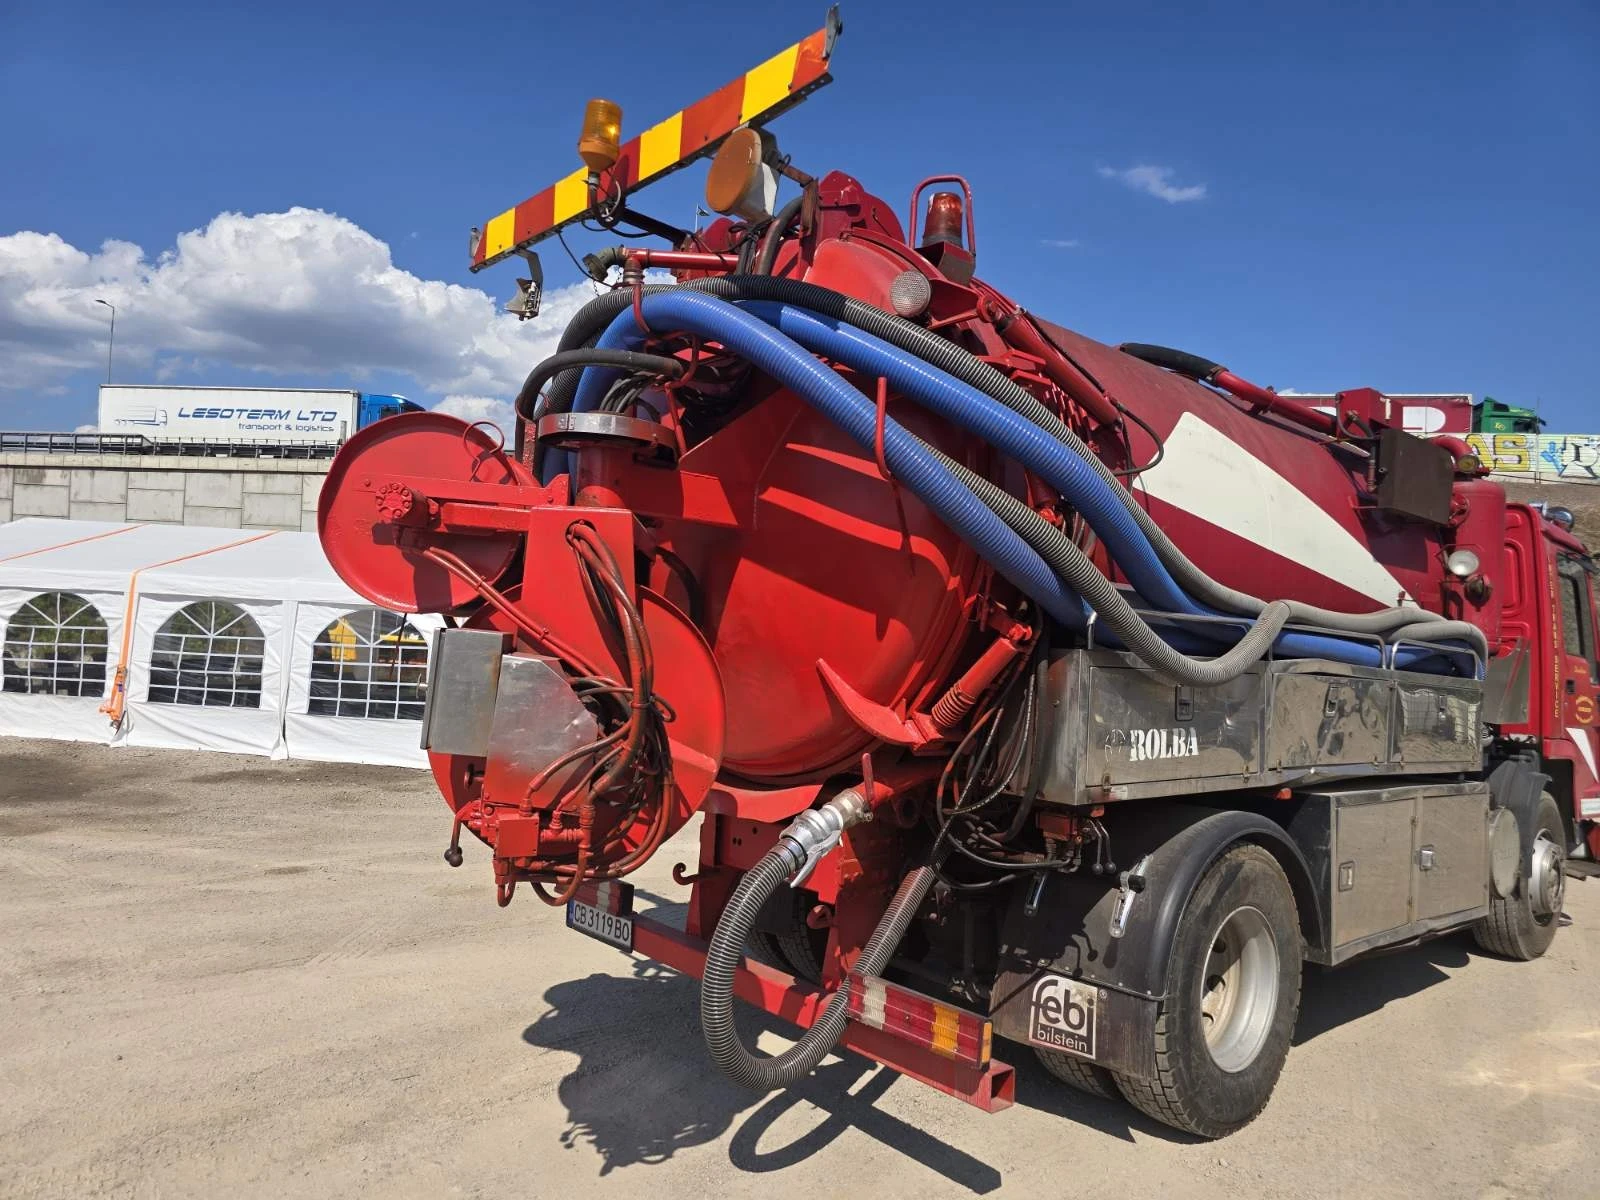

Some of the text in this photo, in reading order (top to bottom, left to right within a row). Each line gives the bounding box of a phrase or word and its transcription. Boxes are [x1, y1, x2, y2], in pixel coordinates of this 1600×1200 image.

[177, 407, 338, 422] LESOTERM LTD
[238, 422, 282, 432] transport
[295, 424, 335, 433] logistics
[1129, 726, 1200, 762] ROLBA
[1031, 977, 1095, 1035] febi
[1037, 1023, 1087, 1053] bilstein
